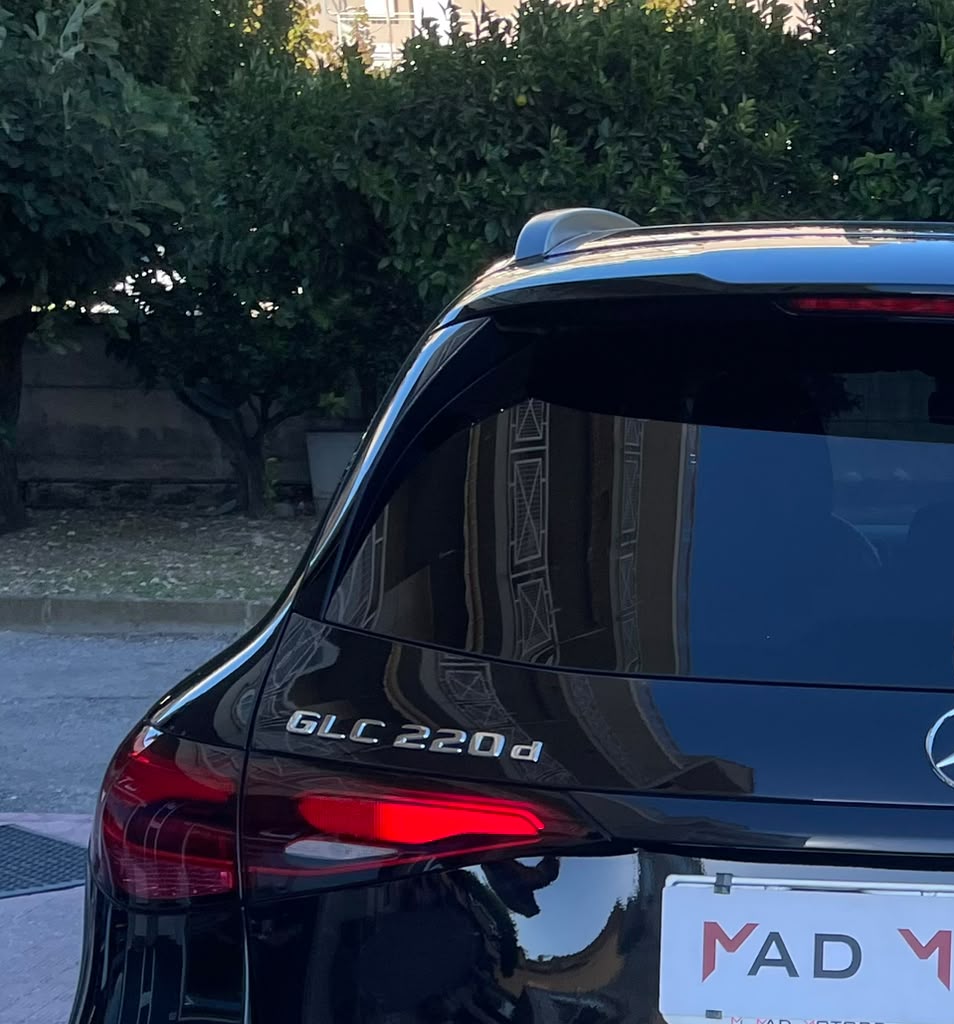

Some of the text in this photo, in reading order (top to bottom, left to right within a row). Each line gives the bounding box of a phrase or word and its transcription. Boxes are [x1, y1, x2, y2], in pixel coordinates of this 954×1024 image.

[286, 710, 543, 762] GLC 220 d
[701, 921, 862, 983] MAD
